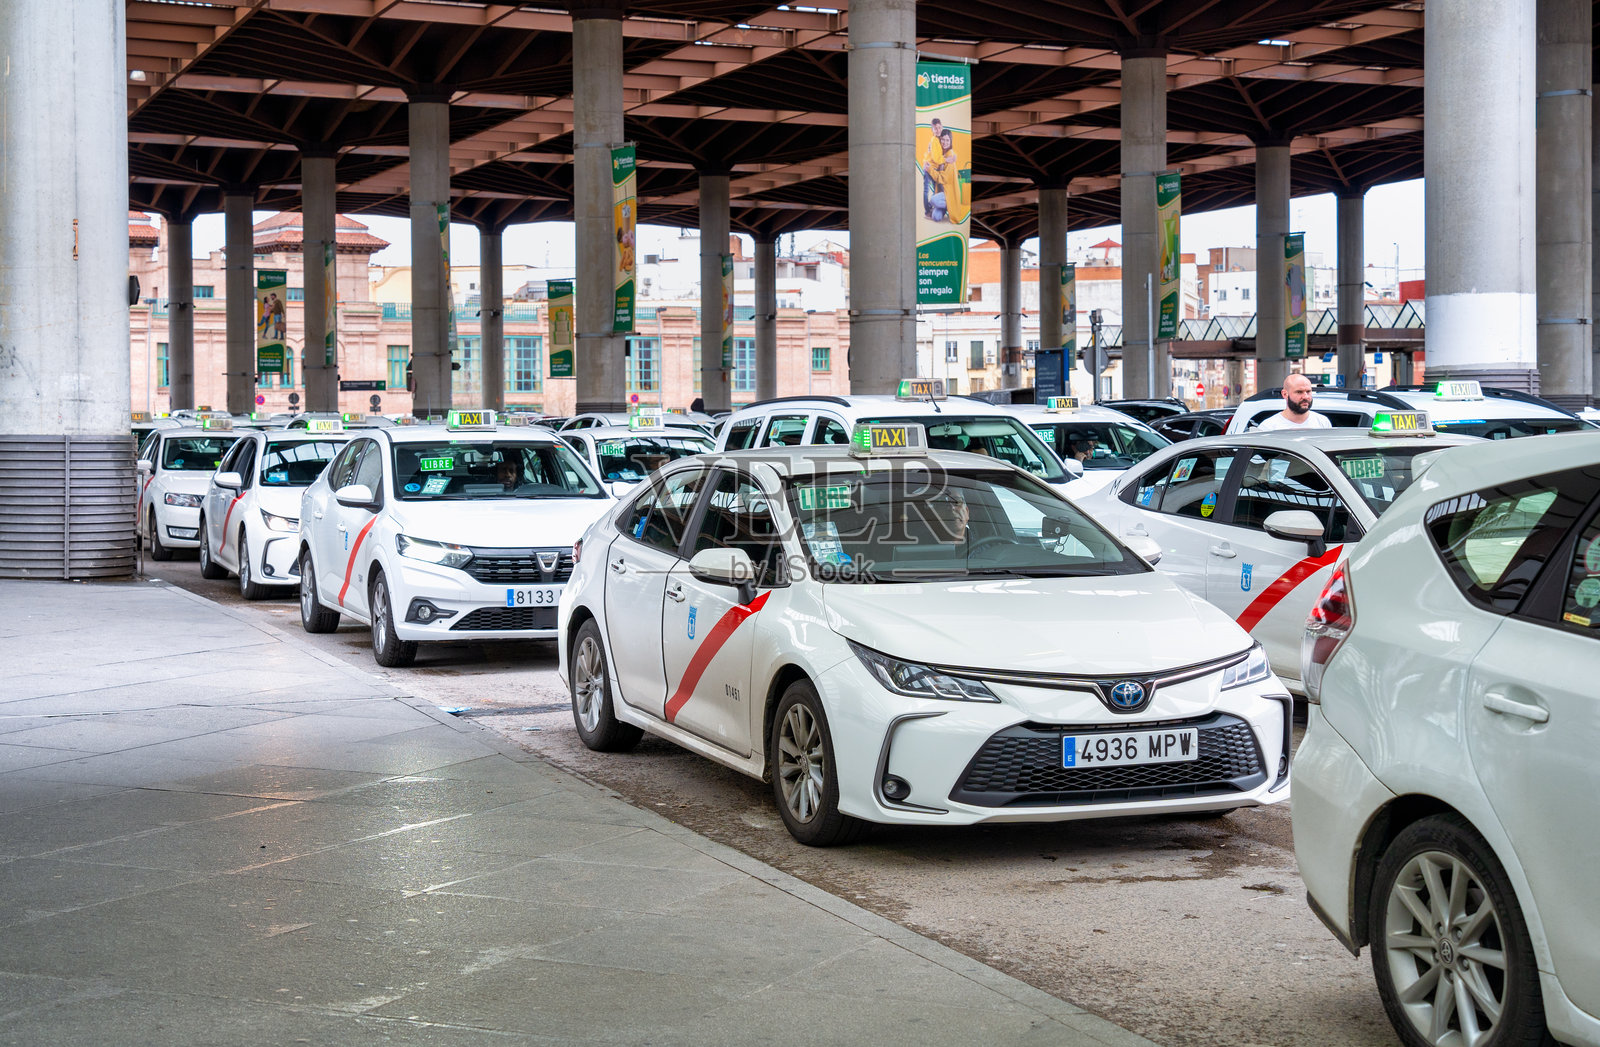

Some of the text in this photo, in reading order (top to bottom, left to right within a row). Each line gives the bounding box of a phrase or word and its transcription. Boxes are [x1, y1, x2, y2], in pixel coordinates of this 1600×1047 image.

[931, 74, 964, 84] tiendas
[919, 267, 948, 278] siempre
[930, 286, 952, 296] regalo
[912, 384, 932, 394] TAXI
[1452, 384, 1470, 396] TAXI
[1056, 398, 1072, 408] TAXI
[460, 414, 482, 424] TAXI
[640, 418, 654, 426] TAXI
[1392, 414, 1416, 430] TAXI
[316, 422, 332, 430] TAXI
[872, 428, 906, 446] TAXI
[424, 460, 450, 469] LIBRE
[801, 486, 850, 510] LIBRE
[516, 590, 554, 604] 8133
[725, 684, 740, 701] 01451
[1081, 737, 1138, 762] 4936
[1148, 732, 1192, 758] MPW
